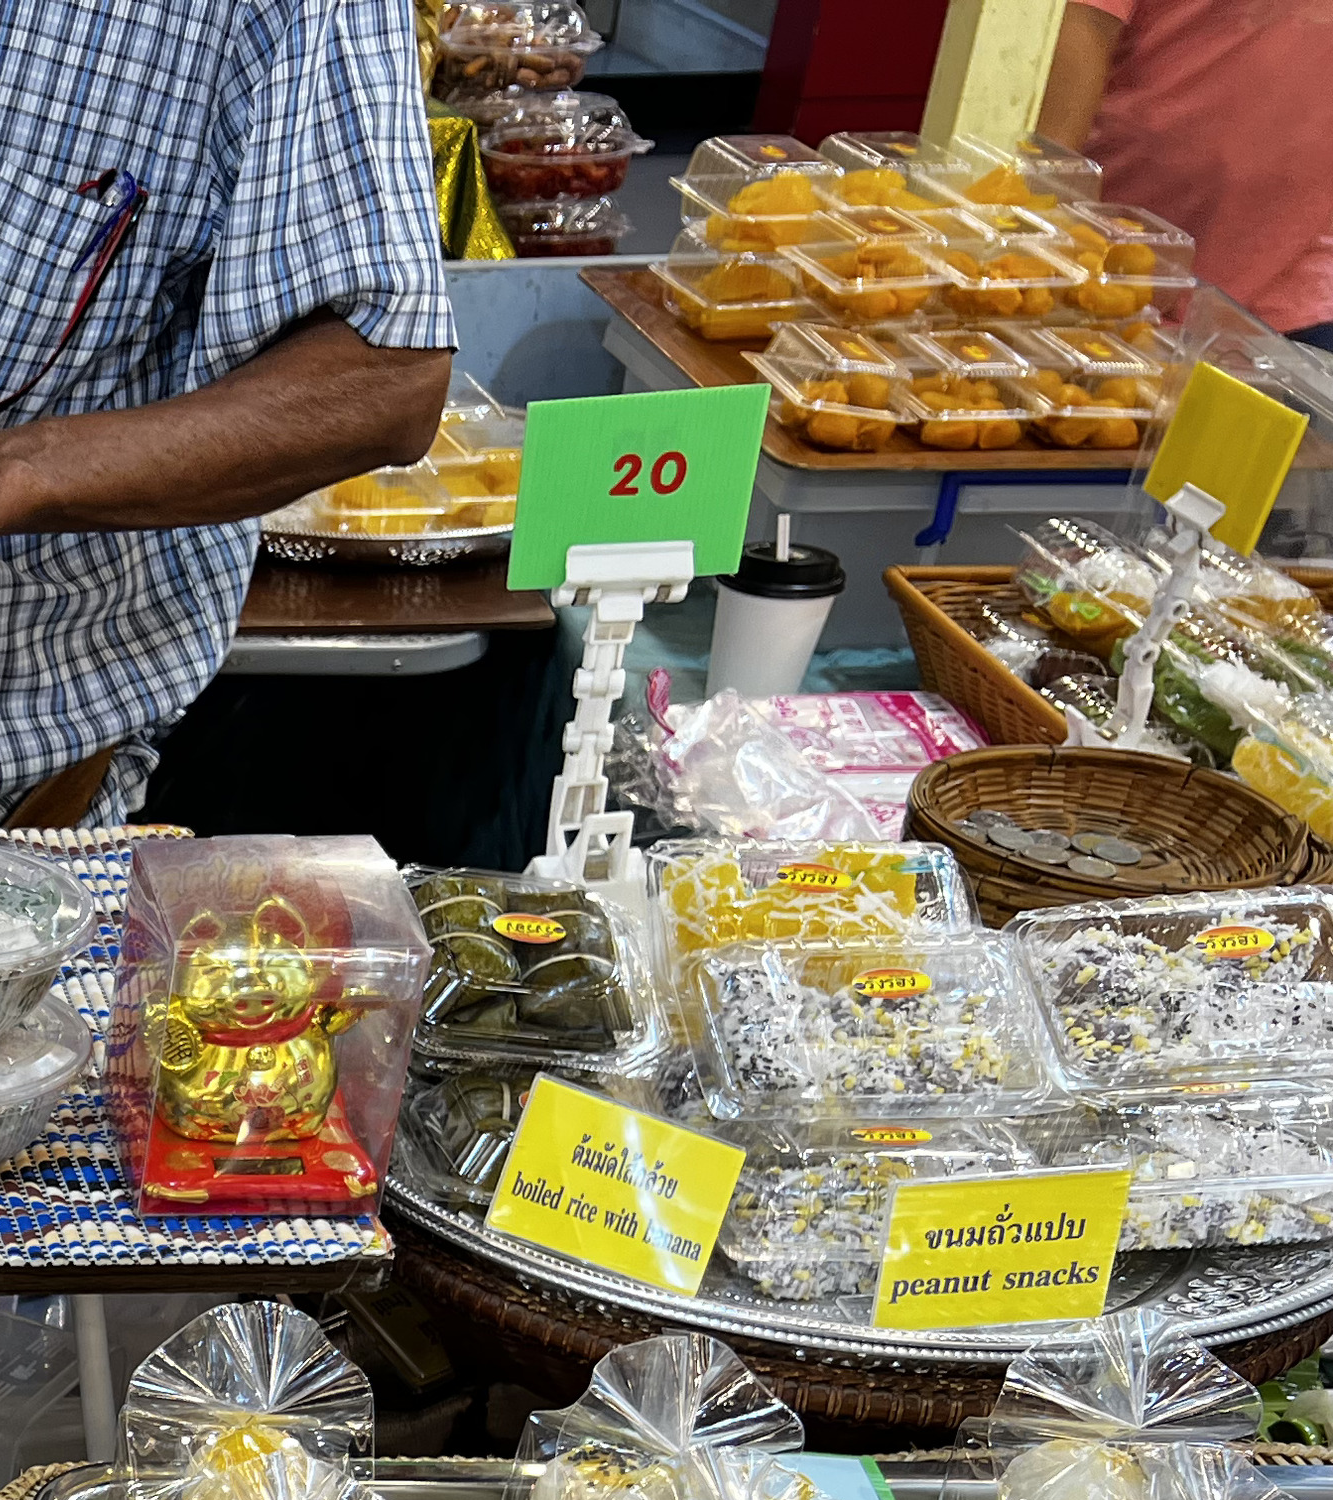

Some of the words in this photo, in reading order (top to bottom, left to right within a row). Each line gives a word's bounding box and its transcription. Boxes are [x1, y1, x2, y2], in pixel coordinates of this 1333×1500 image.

[608, 450, 688, 497] 20
[511, 1171, 565, 1210] boiled
[565, 1192, 598, 1224] rice
[604, 1207, 639, 1239] with
[642, 1218, 702, 1262] banana
[924, 1203, 1086, 1250] ขนมถั่วแปบ
[889, 1269, 992, 1304] peanut
[1002, 1261, 1100, 1291] snacks
